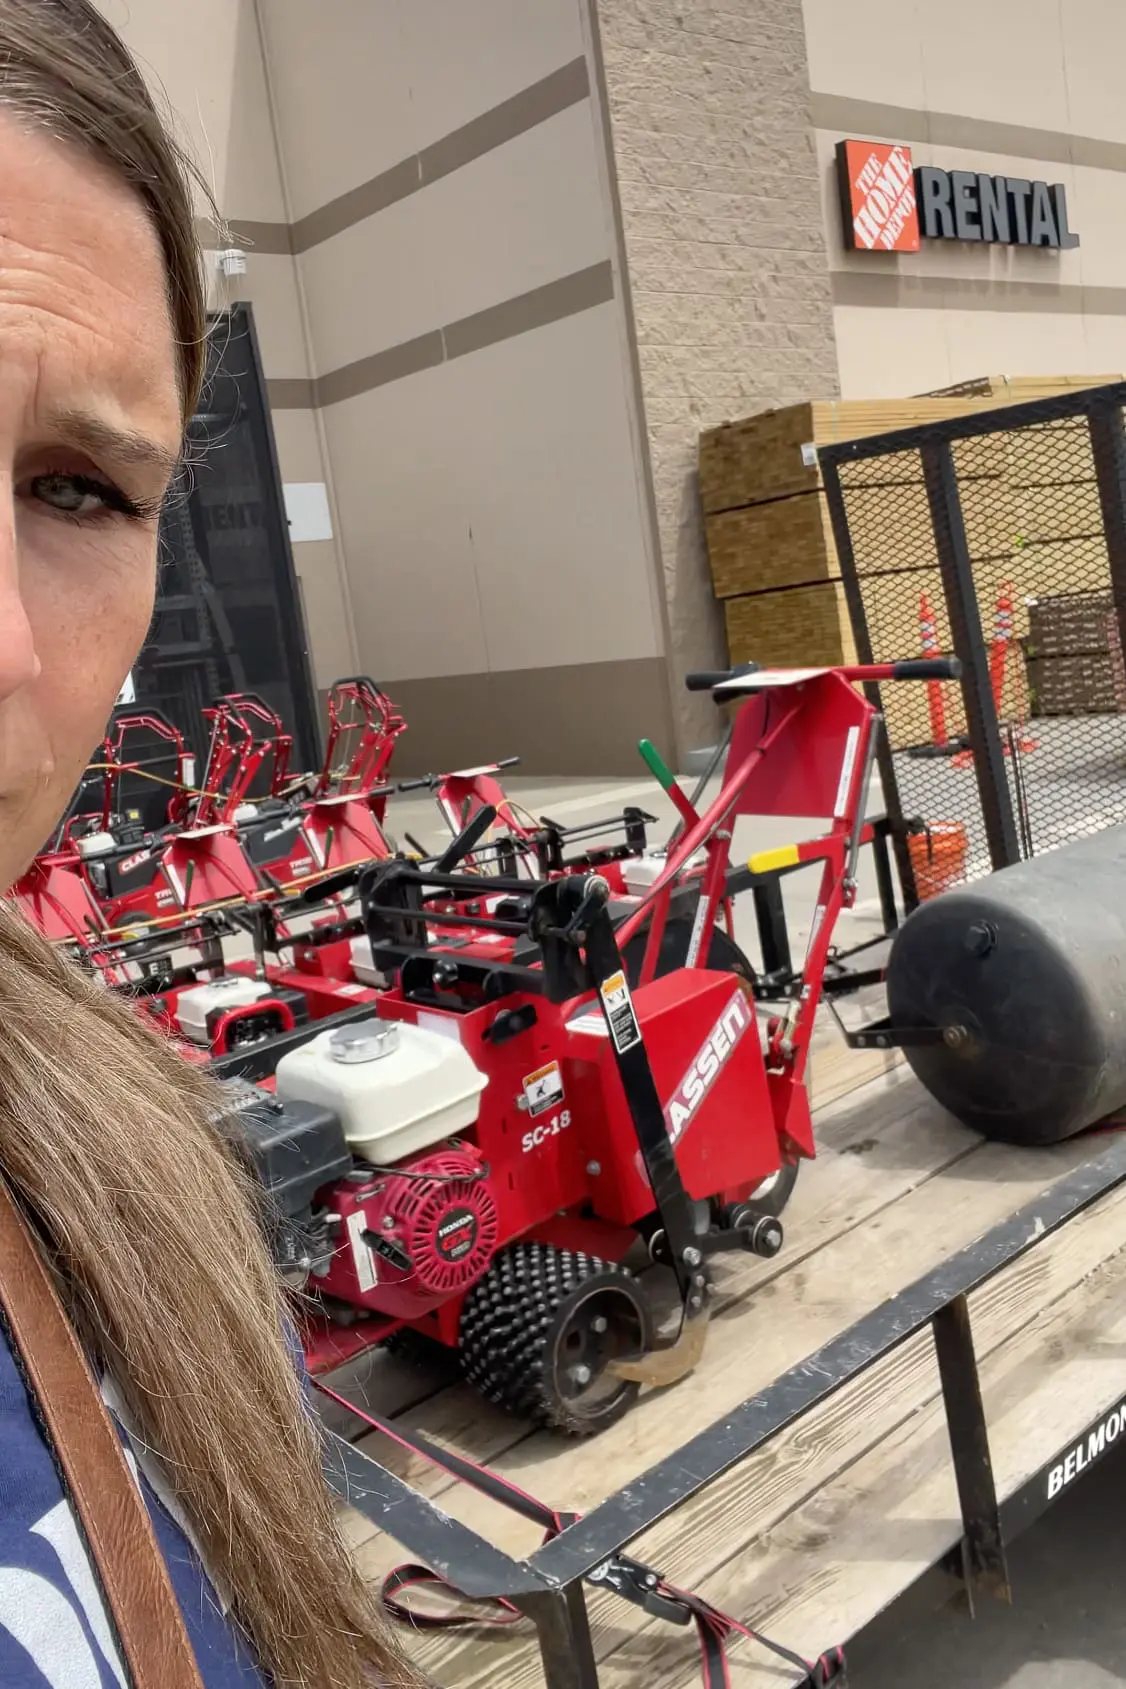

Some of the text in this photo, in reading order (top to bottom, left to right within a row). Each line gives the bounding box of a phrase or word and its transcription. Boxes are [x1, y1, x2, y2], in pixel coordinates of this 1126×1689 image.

[853, 145, 913, 249] HOME
[855, 152, 883, 195] THE
[879, 185, 916, 250] DEPOT
[919, 166, 1080, 250] RENTAL
[668, 1002, 746, 1145] ASSEN
[521, 1109, 572, 1153] SC-18
[438, 1213, 475, 1238] HONDA
